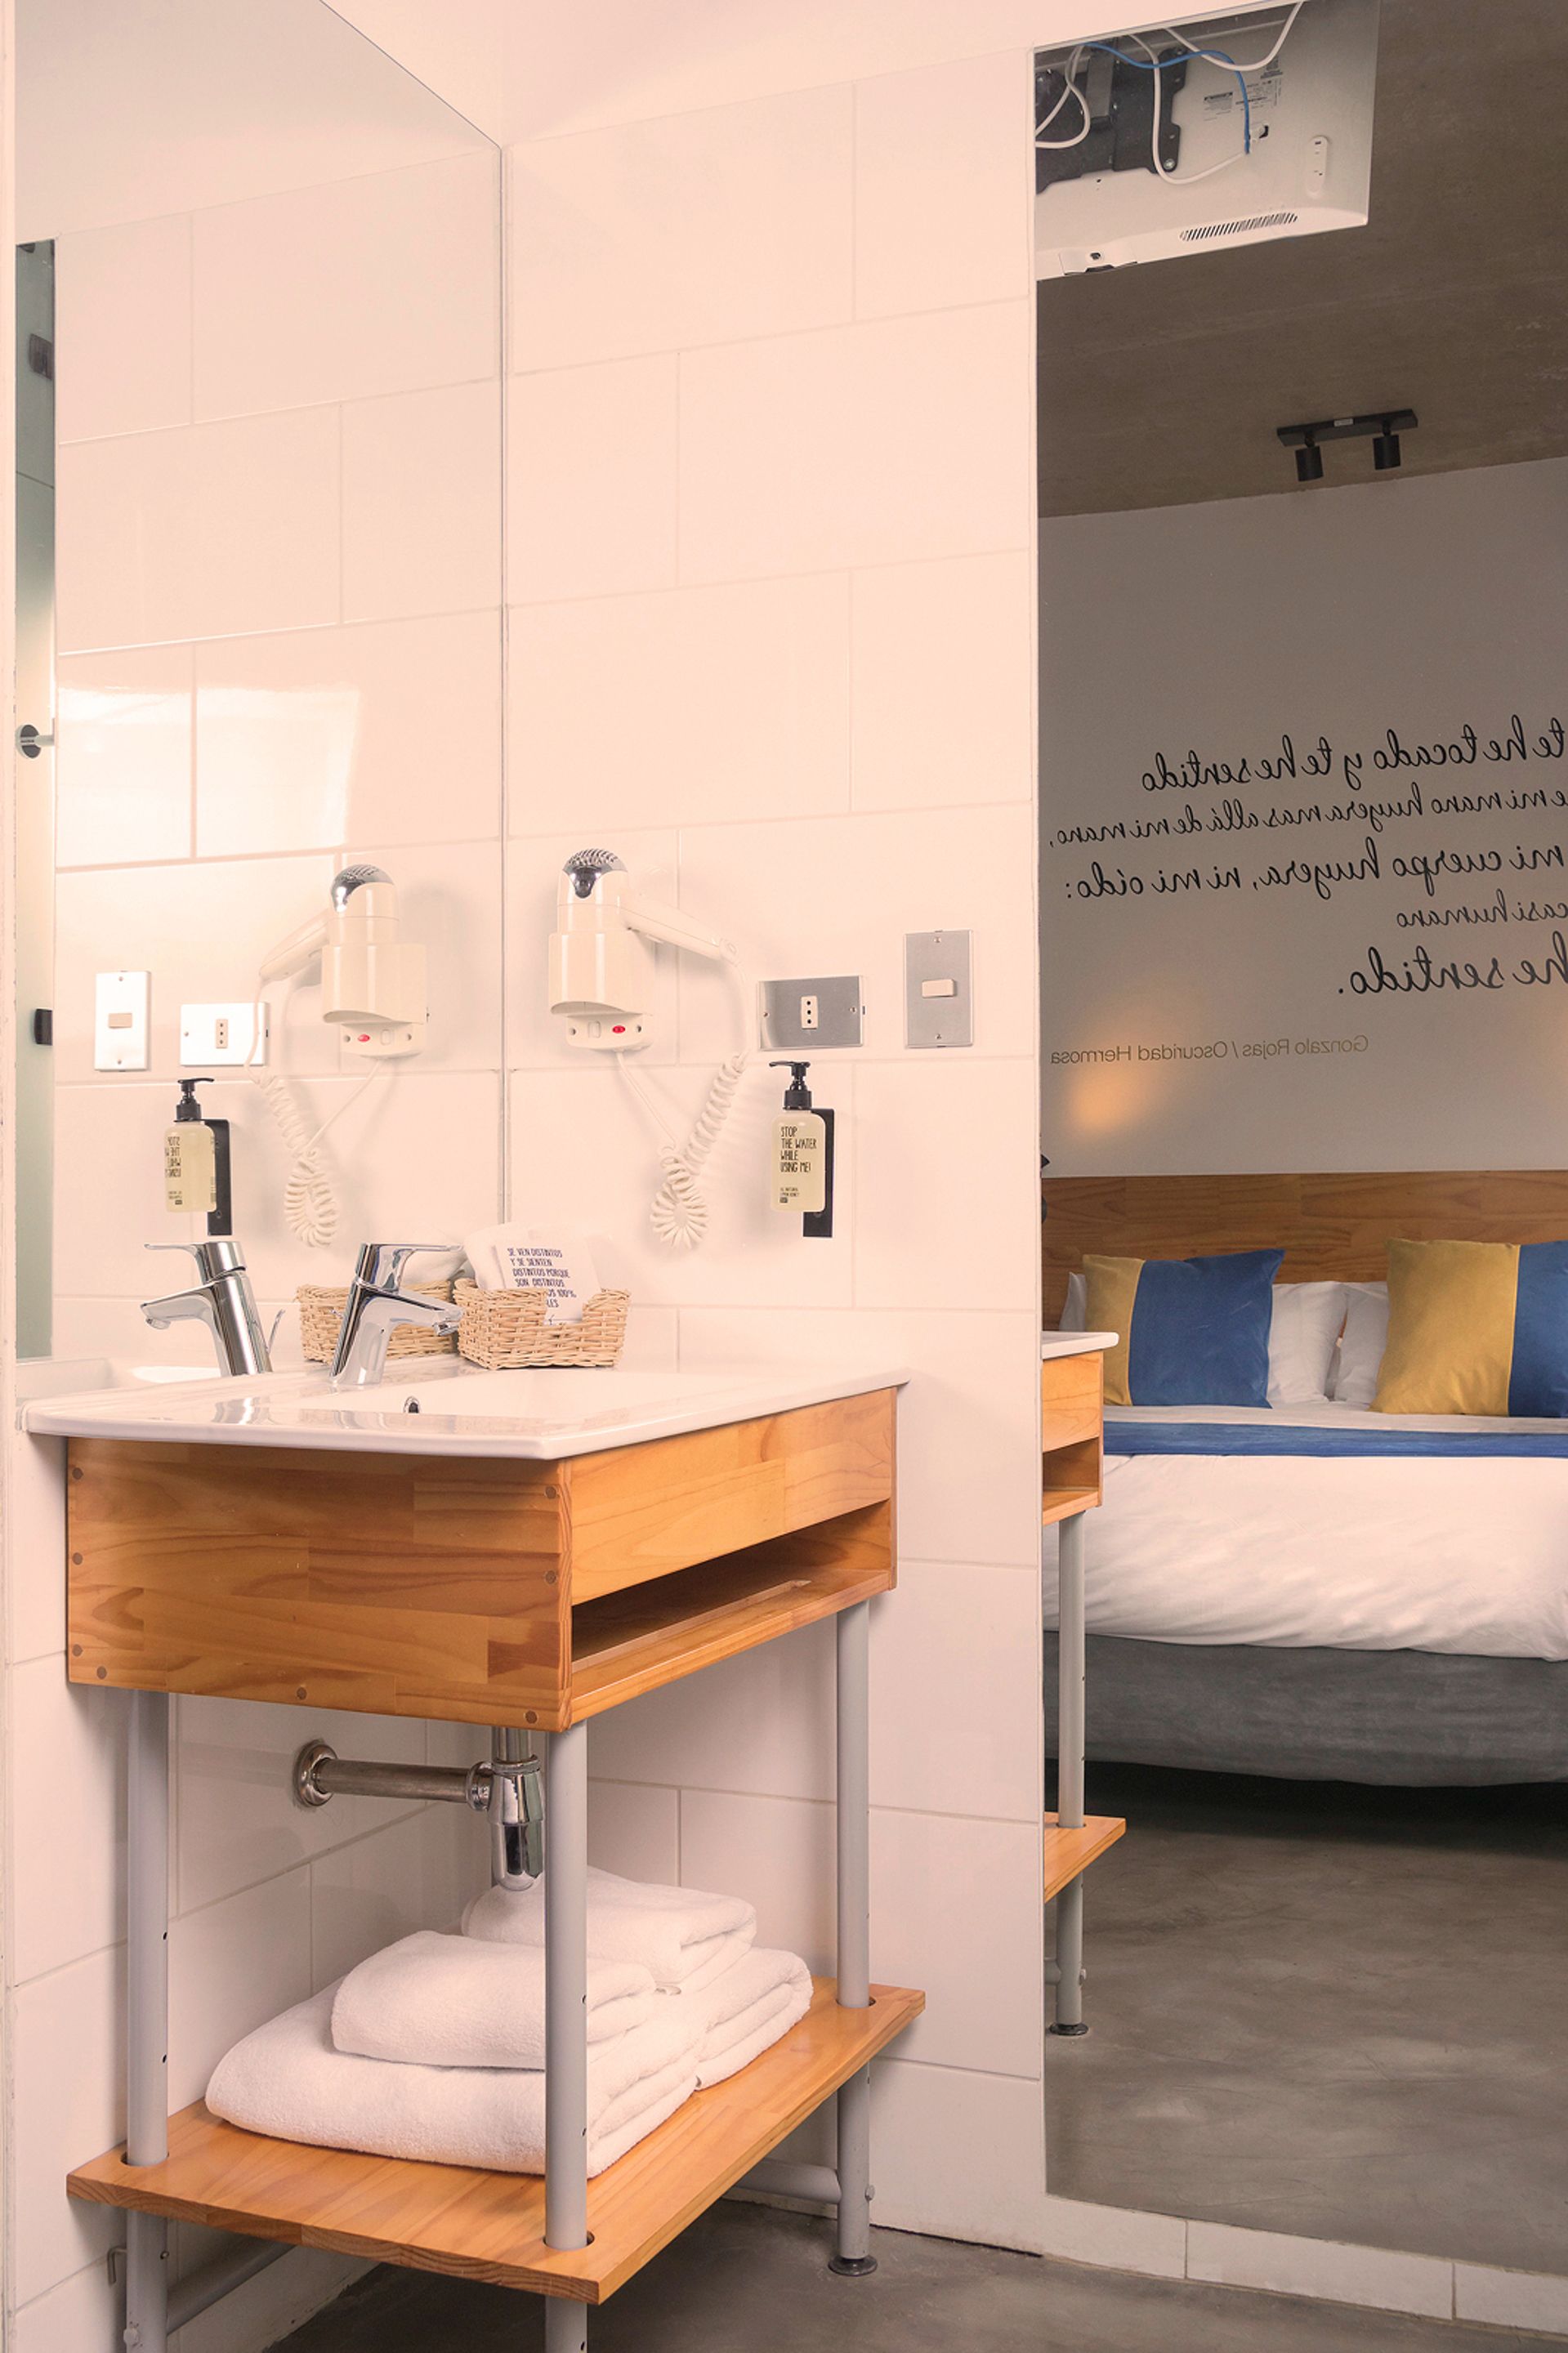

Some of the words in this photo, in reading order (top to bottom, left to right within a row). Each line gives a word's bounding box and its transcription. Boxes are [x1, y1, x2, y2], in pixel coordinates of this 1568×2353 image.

[780, 1126, 797, 1137] STOP
[781, 1137, 793, 1149] THE
[795, 1138, 817, 1150] WATER
[780, 1150, 798, 1161] WHILE
[780, 1161, 798, 1173] USING
[799, 1161, 811, 1172] ME!
[516, 1248, 529, 1257] VEN
[530, 1248, 563, 1258] DISTINTOS
[526, 1257, 552, 1266] SIENTEN
[512, 1267, 546, 1277] DISTINTOS
[546, 1268, 570, 1279] PORQUE
[532, 1278, 565, 1288] DISTINTOS
